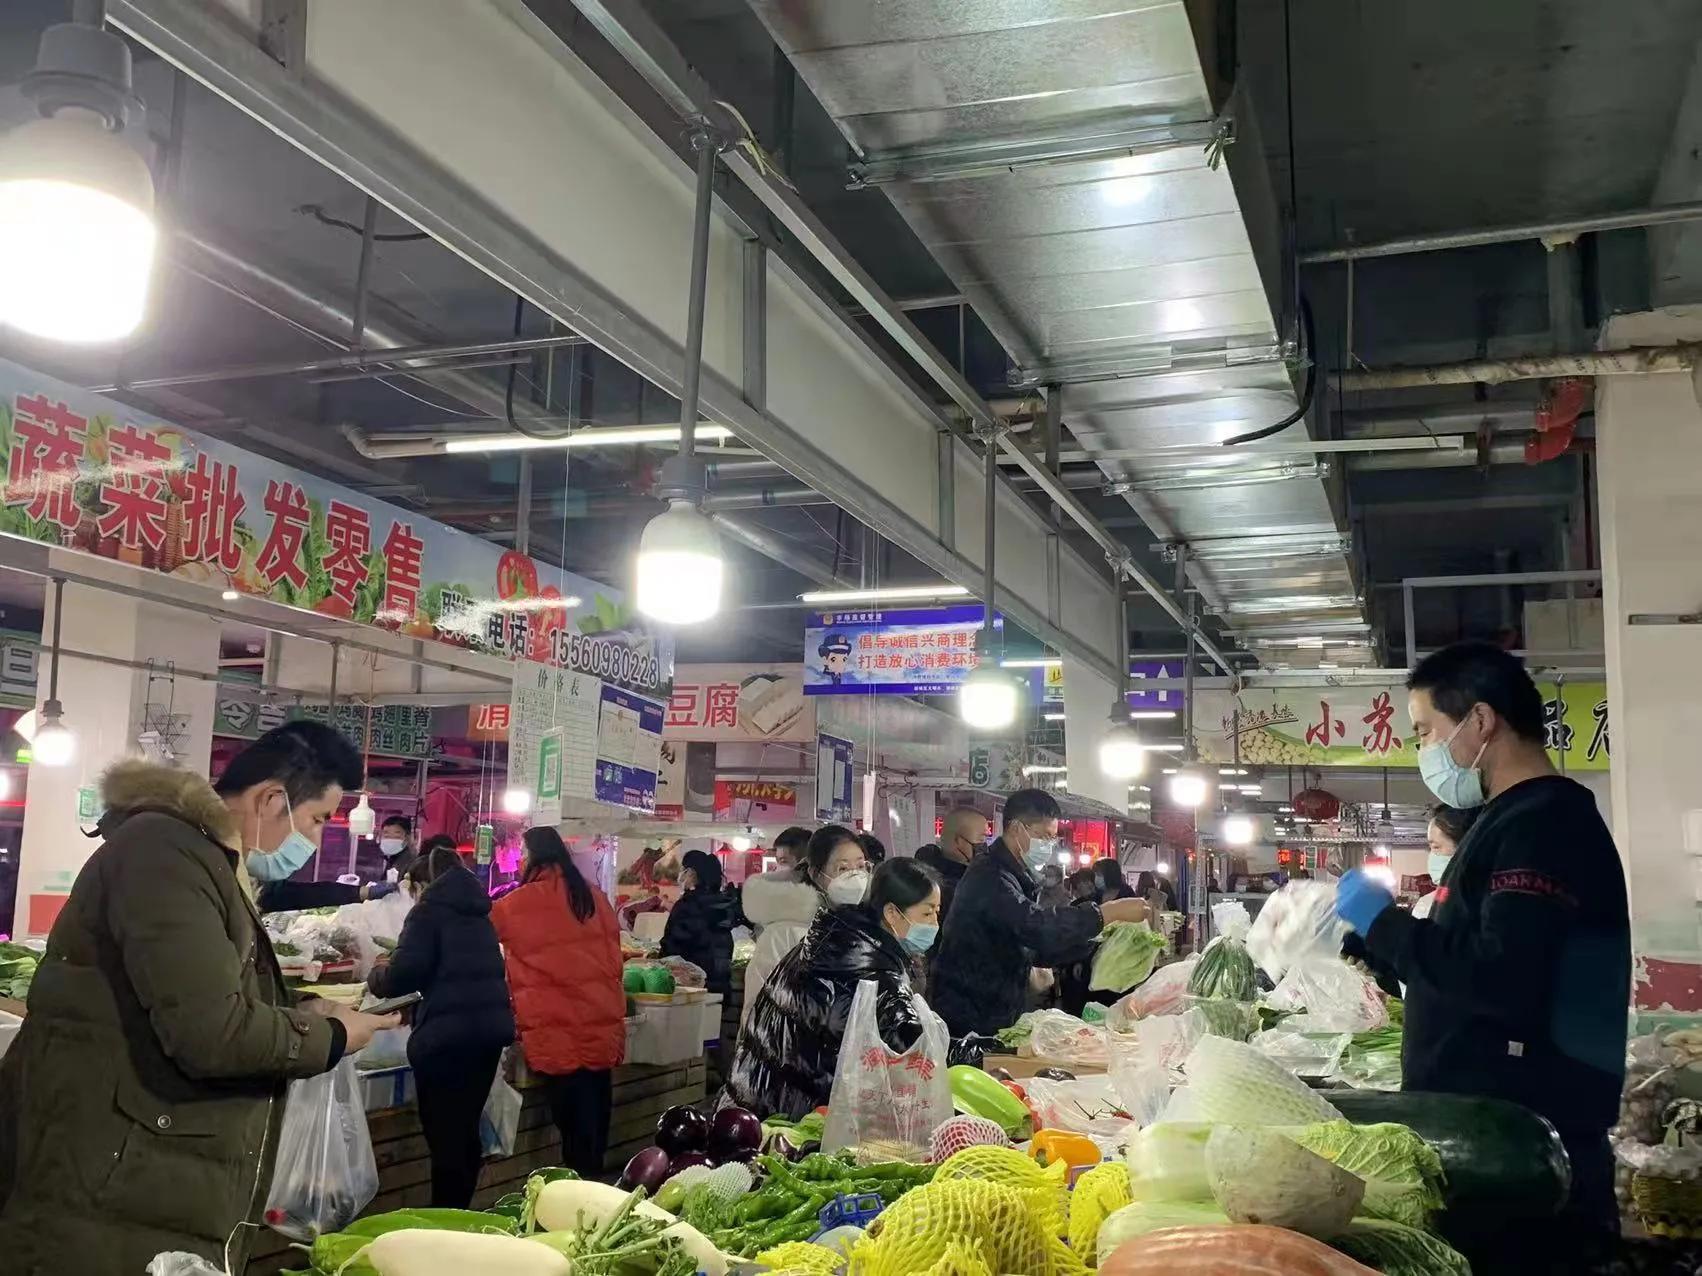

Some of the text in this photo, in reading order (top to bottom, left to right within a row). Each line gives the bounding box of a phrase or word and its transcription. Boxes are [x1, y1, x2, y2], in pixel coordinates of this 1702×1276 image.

[5, 394, 425, 621] 蔬菜批发零售
[537, 667, 580, 697] 价格表
[664, 682, 740, 728] 豆腐
[1305, 691, 1402, 754] 小苏
